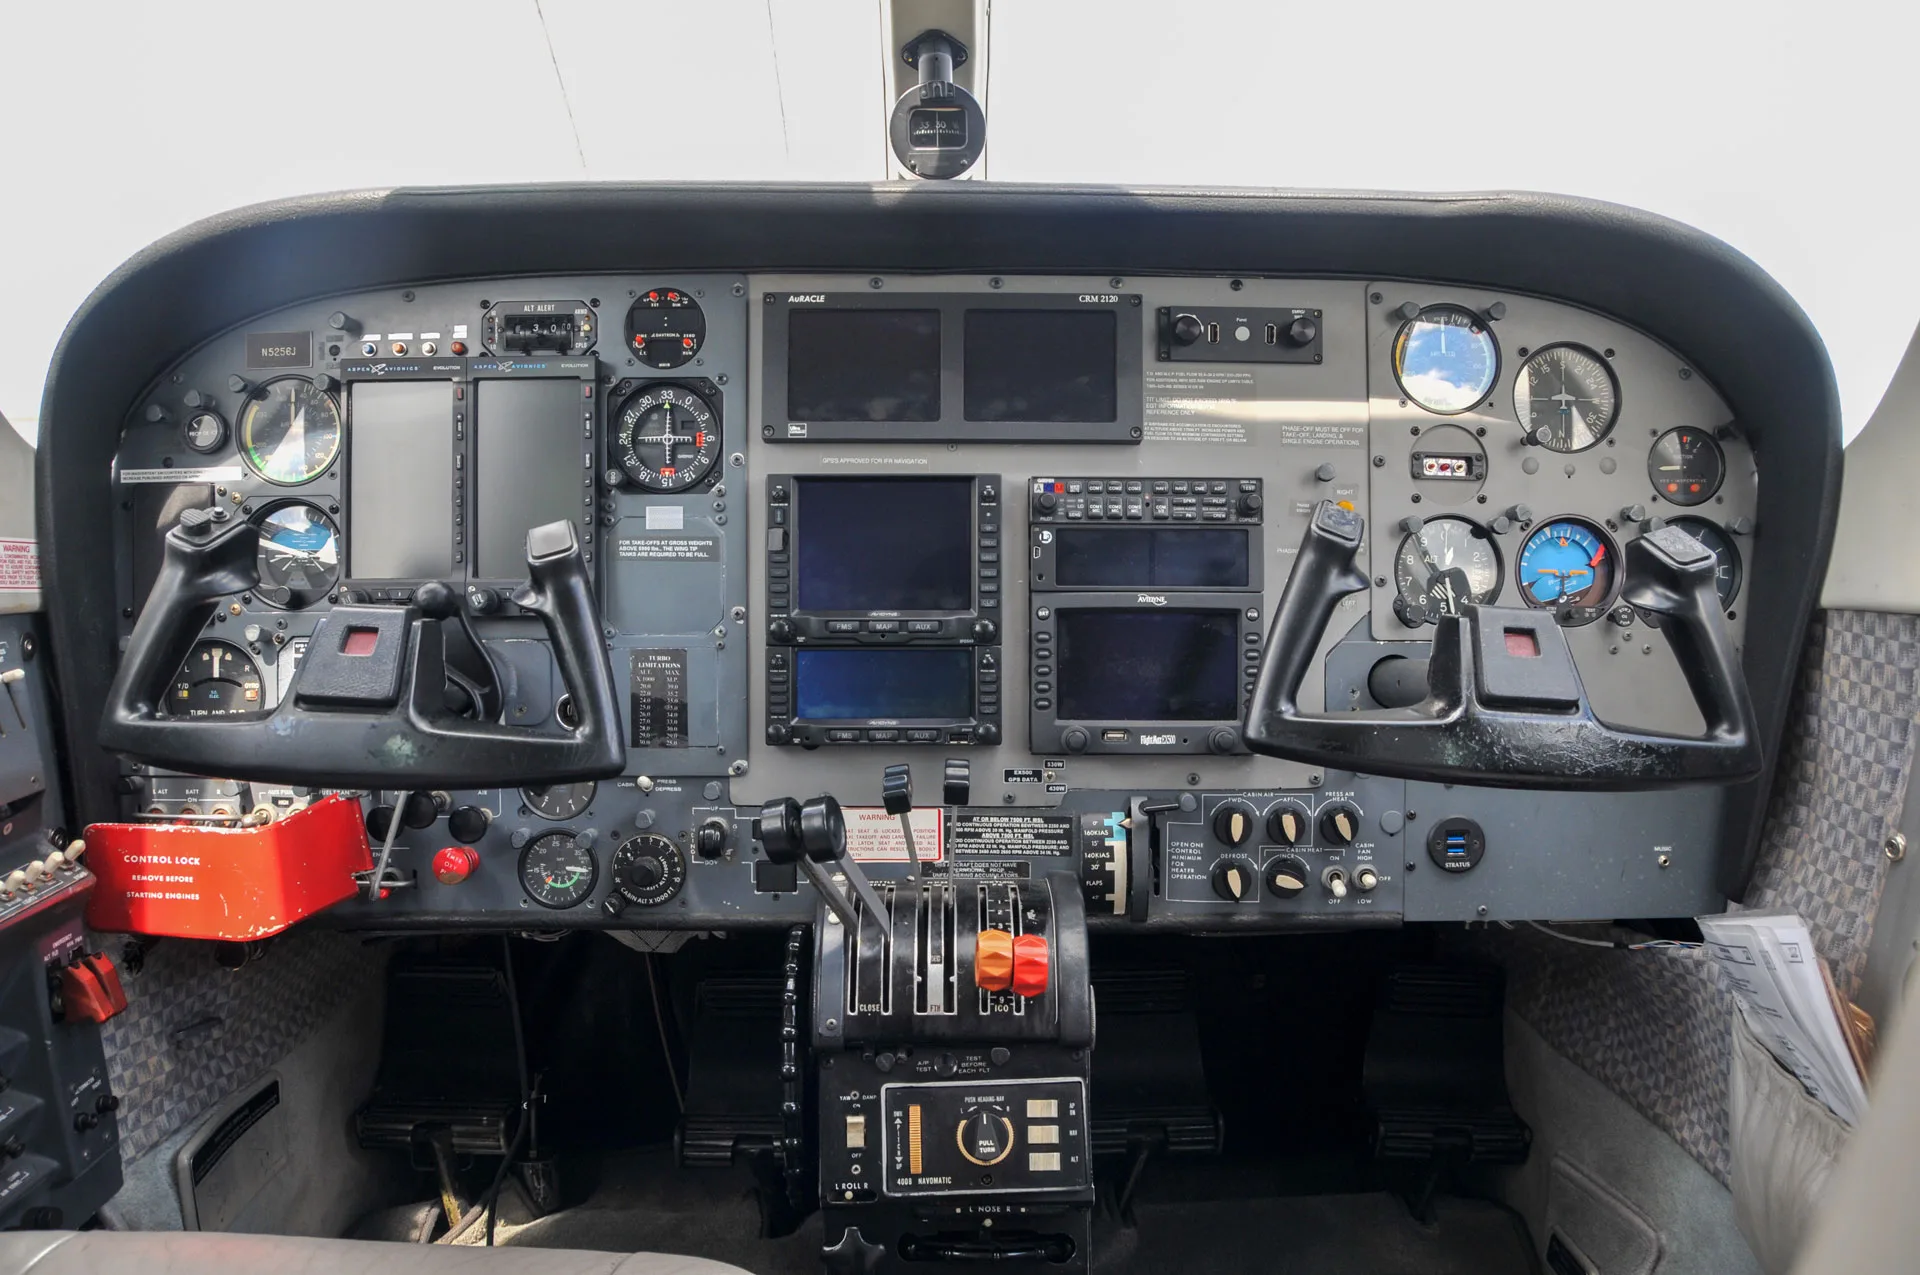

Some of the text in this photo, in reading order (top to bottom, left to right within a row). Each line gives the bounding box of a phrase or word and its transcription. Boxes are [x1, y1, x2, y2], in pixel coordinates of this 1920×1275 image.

[788, 295, 825, 303] AuRACLE
[1079, 295, 1118, 303] CRM 2120
[537, 304, 555, 312] ALERT
[262, 347, 296, 357] N5256J
[1540, 364, 1550, 374] 15
[661, 391, 673, 399] 33
[640, 395, 652, 407] 30
[624, 411, 636, 423] 27
[619, 433, 628, 445] 24
[624, 456, 635, 467] 21
[640, 472, 651, 484] 18
[685, 471, 696, 482] 12
[662, 478, 673, 487] 15
[1407, 555, 1414, 565] 8
[1473, 552, 1480, 562] 2
[1406, 577, 1412, 586] 7
[1419, 595, 1426, 605] 6
[1461, 596, 1468, 604] 4
[1440, 603, 1447, 612] 5
[124, 855, 200, 867] CONTROL LOCK
[165, 875, 194, 883] BEFORE
[165, 892, 200, 900] ENGINES
[621, 888, 638, 904] CABIN
[654, 893, 670, 903] 1000
[667, 887, 675, 896] FT
[859, 1004, 881, 1012] CLOSE
[994, 1004, 1009, 1012] ICO
